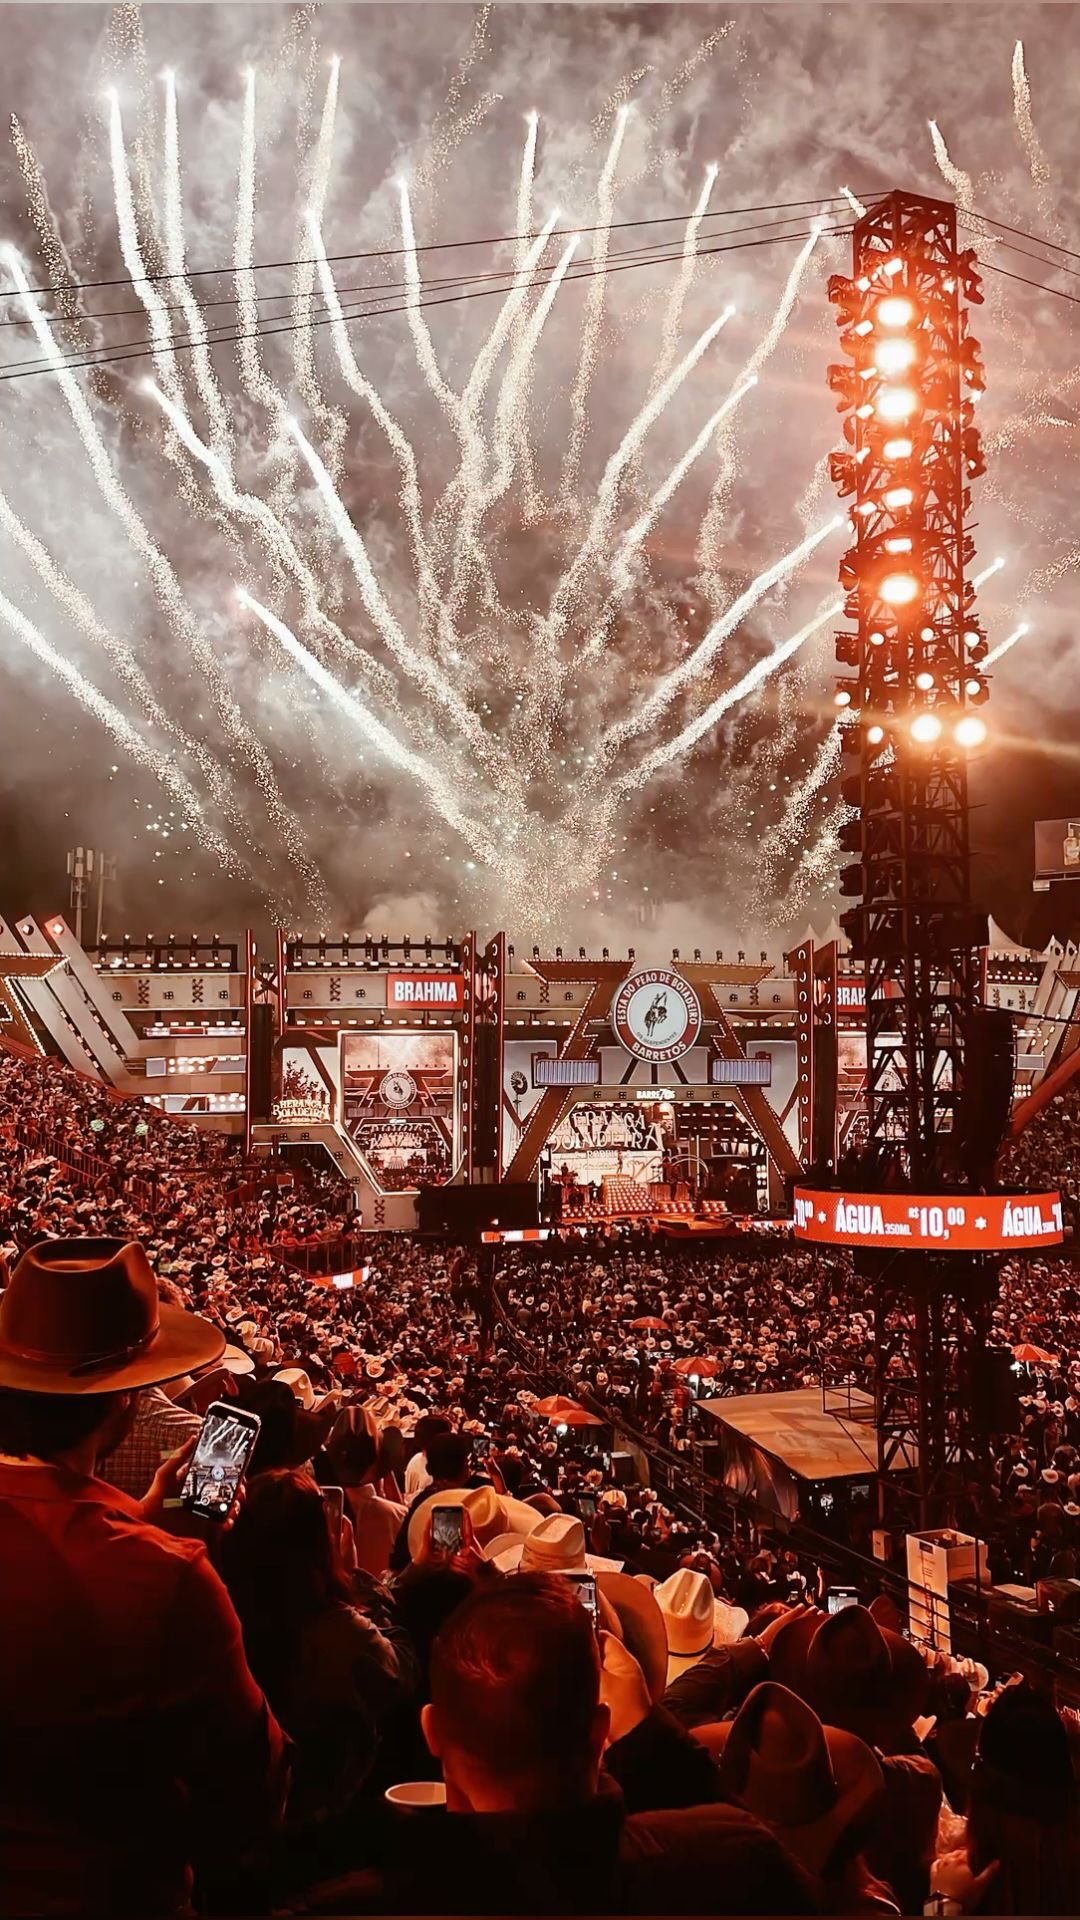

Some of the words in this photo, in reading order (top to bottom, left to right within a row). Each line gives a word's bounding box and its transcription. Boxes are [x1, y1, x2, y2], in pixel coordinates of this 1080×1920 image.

[394, 981, 458, 1002] BRAHMA
[616, 998, 629, 1025] FESTA
[623, 983, 636, 999] DO
[659, 973, 672, 984] DE
[671, 978, 698, 1025] BOIADEIRO
[631, 1040, 687, 1061] BARRETOS
[834, 1197, 884, 1235] ÁGUA
[1001, 1200, 1043, 1237] ÁGUA
